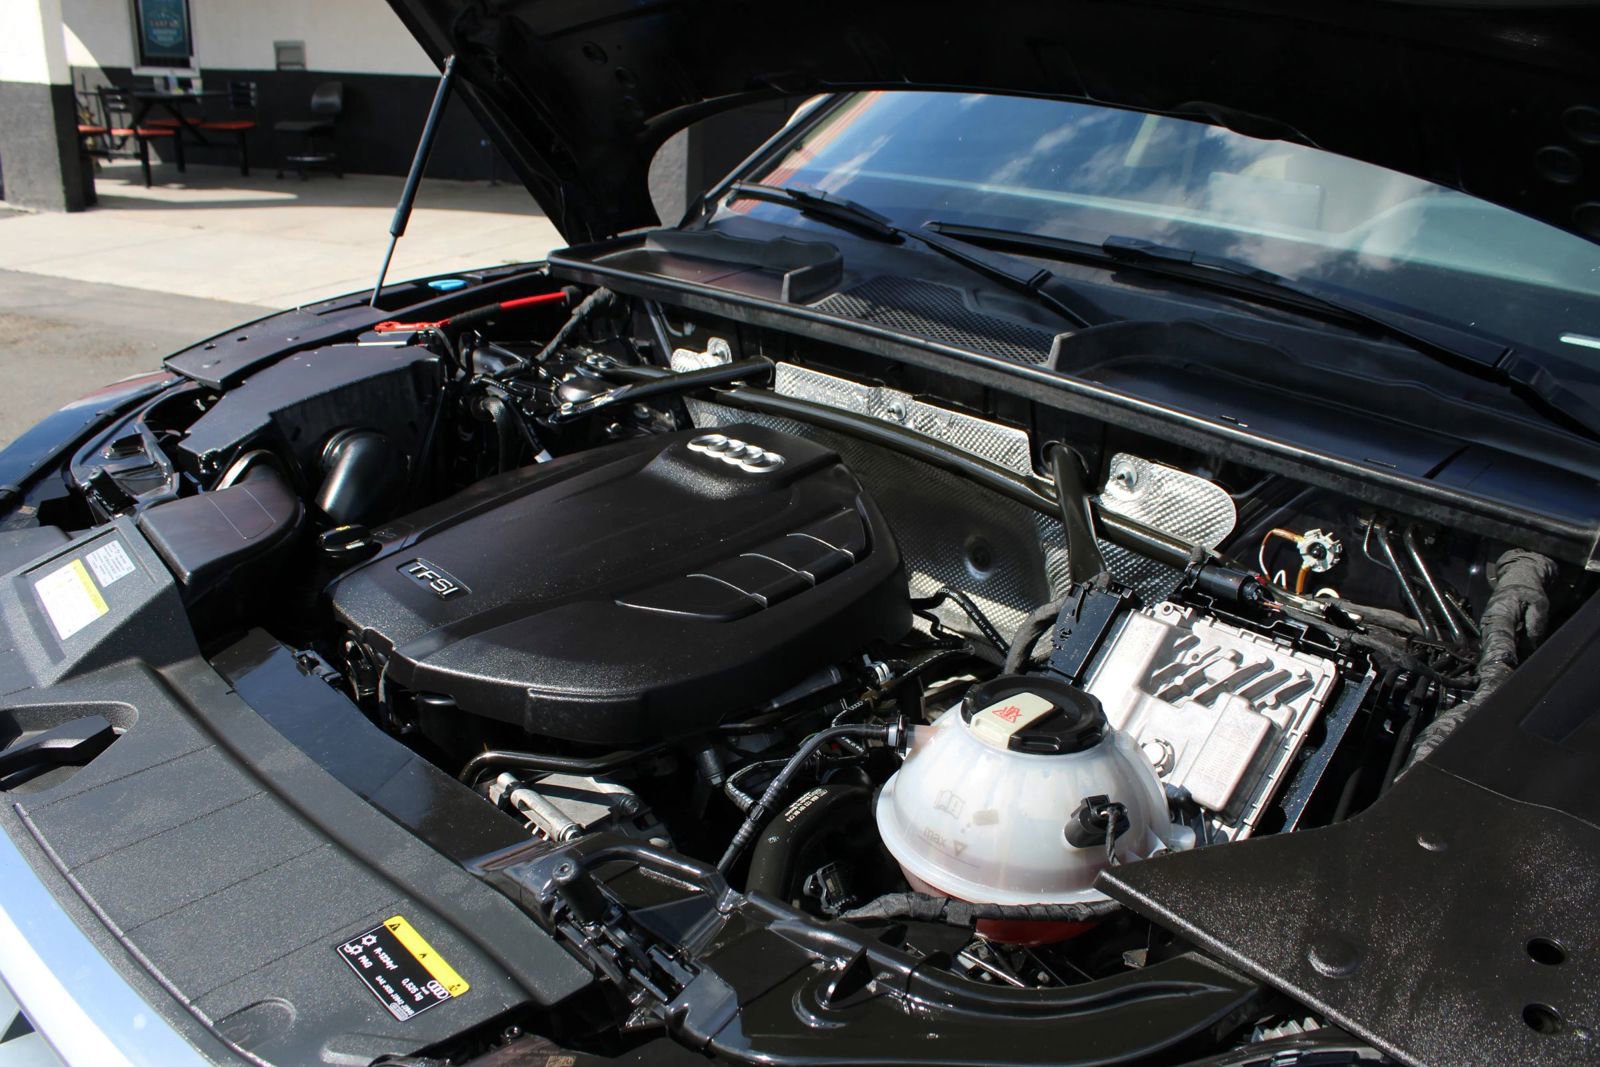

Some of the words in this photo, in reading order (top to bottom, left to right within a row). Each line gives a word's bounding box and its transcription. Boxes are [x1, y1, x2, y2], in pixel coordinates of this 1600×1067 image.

[408, 561, 459, 596] TFSI
[923, 826, 946, 848] max
[358, 954, 373, 969] PAG
